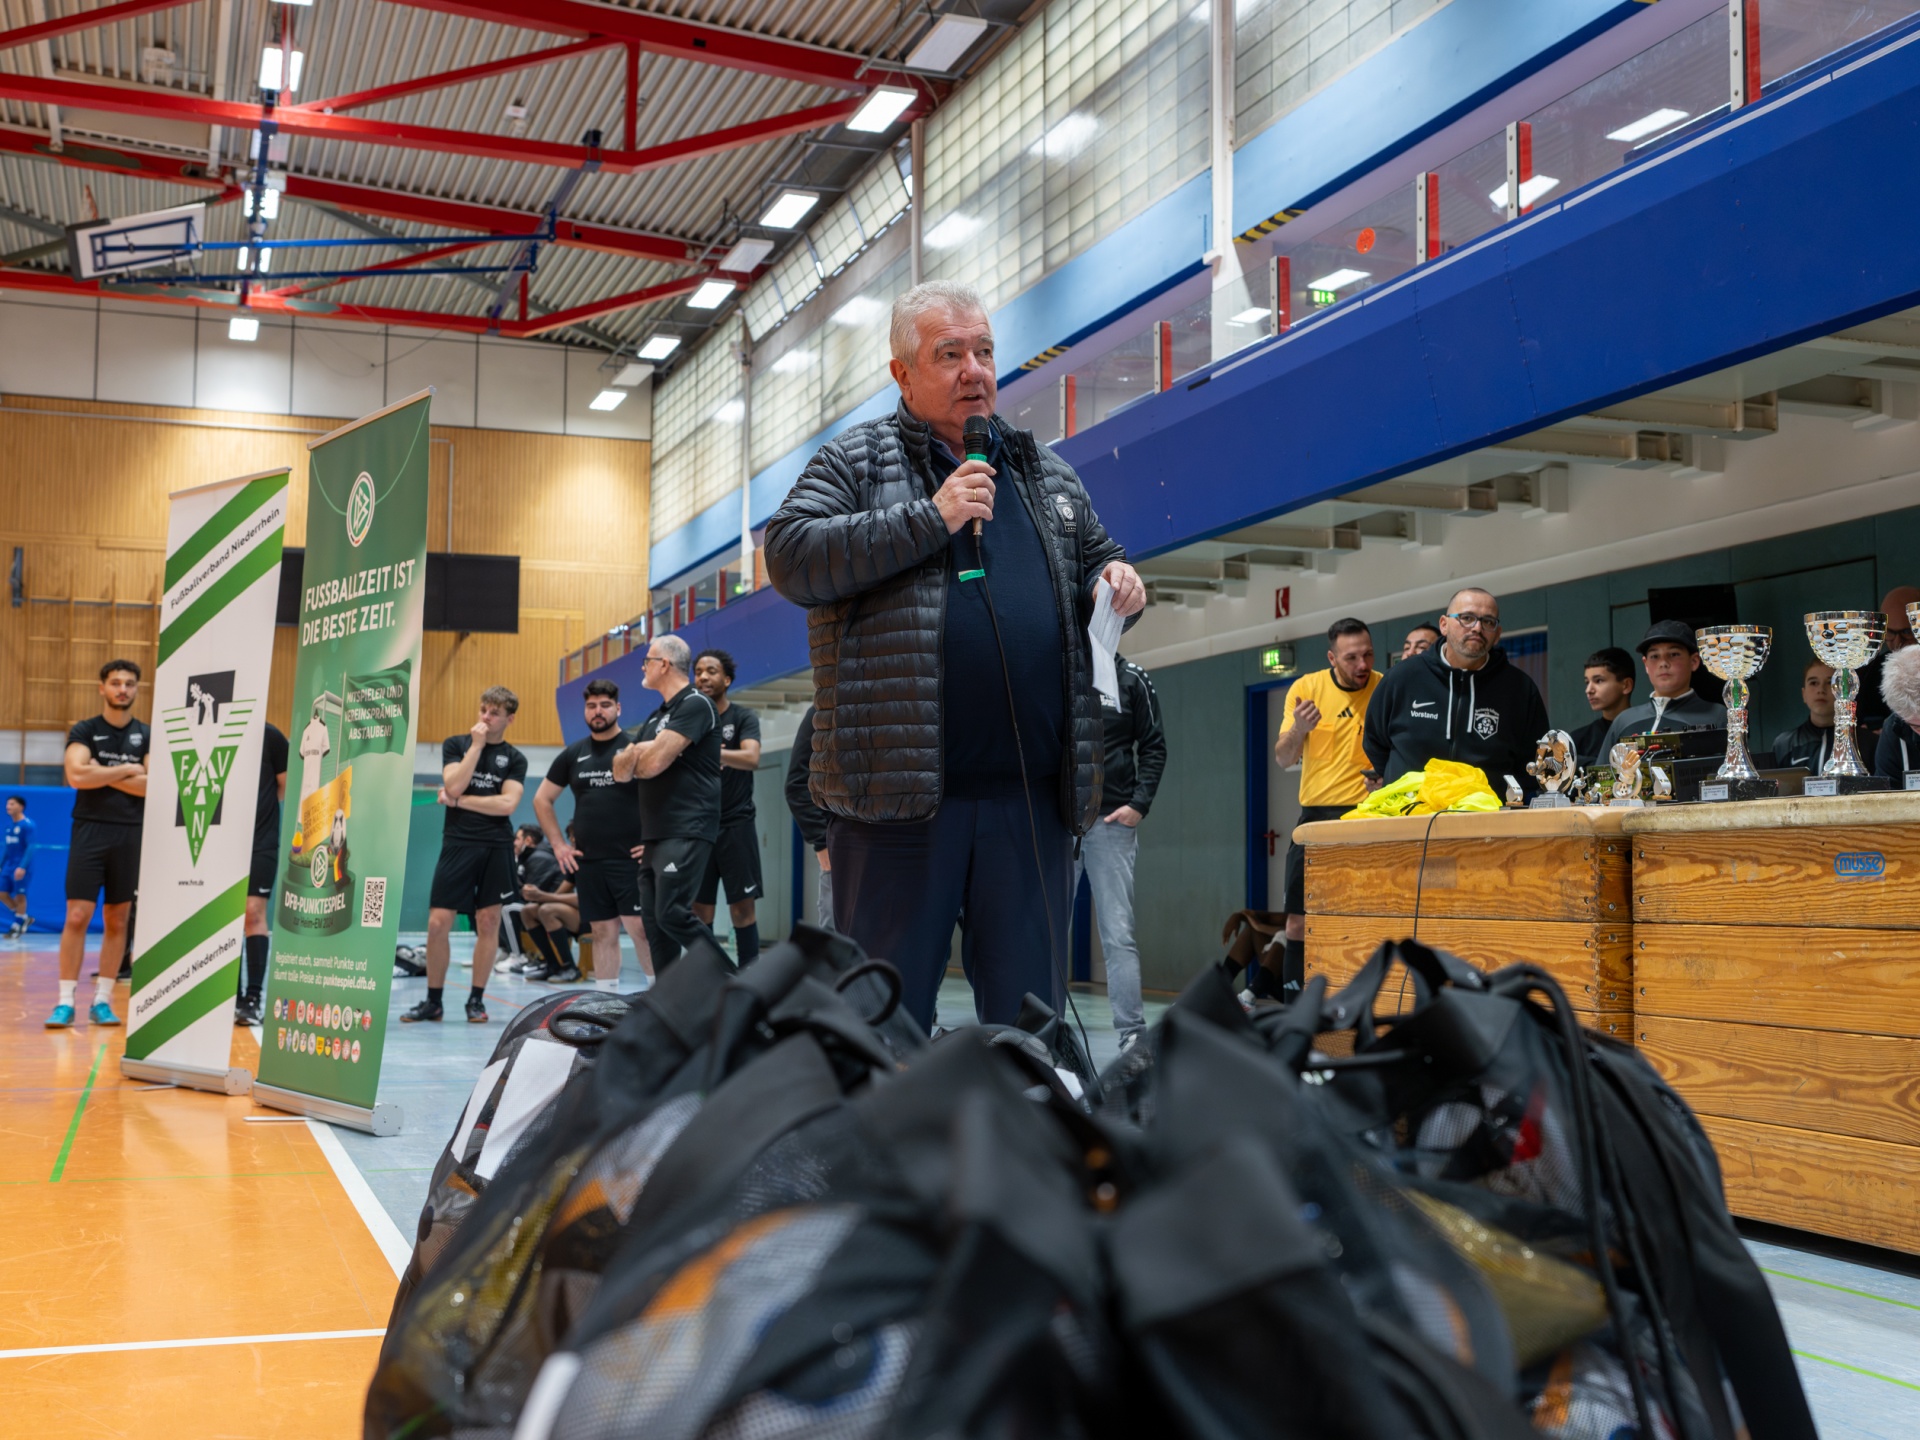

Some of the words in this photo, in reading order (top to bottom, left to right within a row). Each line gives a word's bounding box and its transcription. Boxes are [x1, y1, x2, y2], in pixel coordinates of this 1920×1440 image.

[170, 548, 230, 609] Fußballverband
[231, 508, 280, 554] Niederrhein
[305, 565, 391, 613] FUSSBALLZEIT
[393, 559, 415, 589] IST
[302, 618, 321, 647] DIE
[321, 608, 358, 641] BESTE
[359, 601, 395, 631] ZEIT.
[346, 687, 385, 704] MITSPIELEN
[386, 684, 403, 699] UND
[344, 703, 403, 722] VEREINSPRÄMIEN
[1410, 710, 1439, 720] Vorstand
[348, 725, 392, 740] ABSTAUBEN!
[284, 890, 346, 914] DFB-PUNKTESPIEL
[275, 951, 298, 966] Registriert
[298, 954, 312, 968] euch,
[313, 956, 333, 969] sammelt
[333, 956, 355, 971] Punkte
[355, 959, 367, 971] und
[136, 967, 190, 1016] Fußballverband
[191, 937, 236, 975] Niederrhein
[299, 970, 314, 984] Preise
[322, 973, 376, 991] punktespiel.dfb.de
